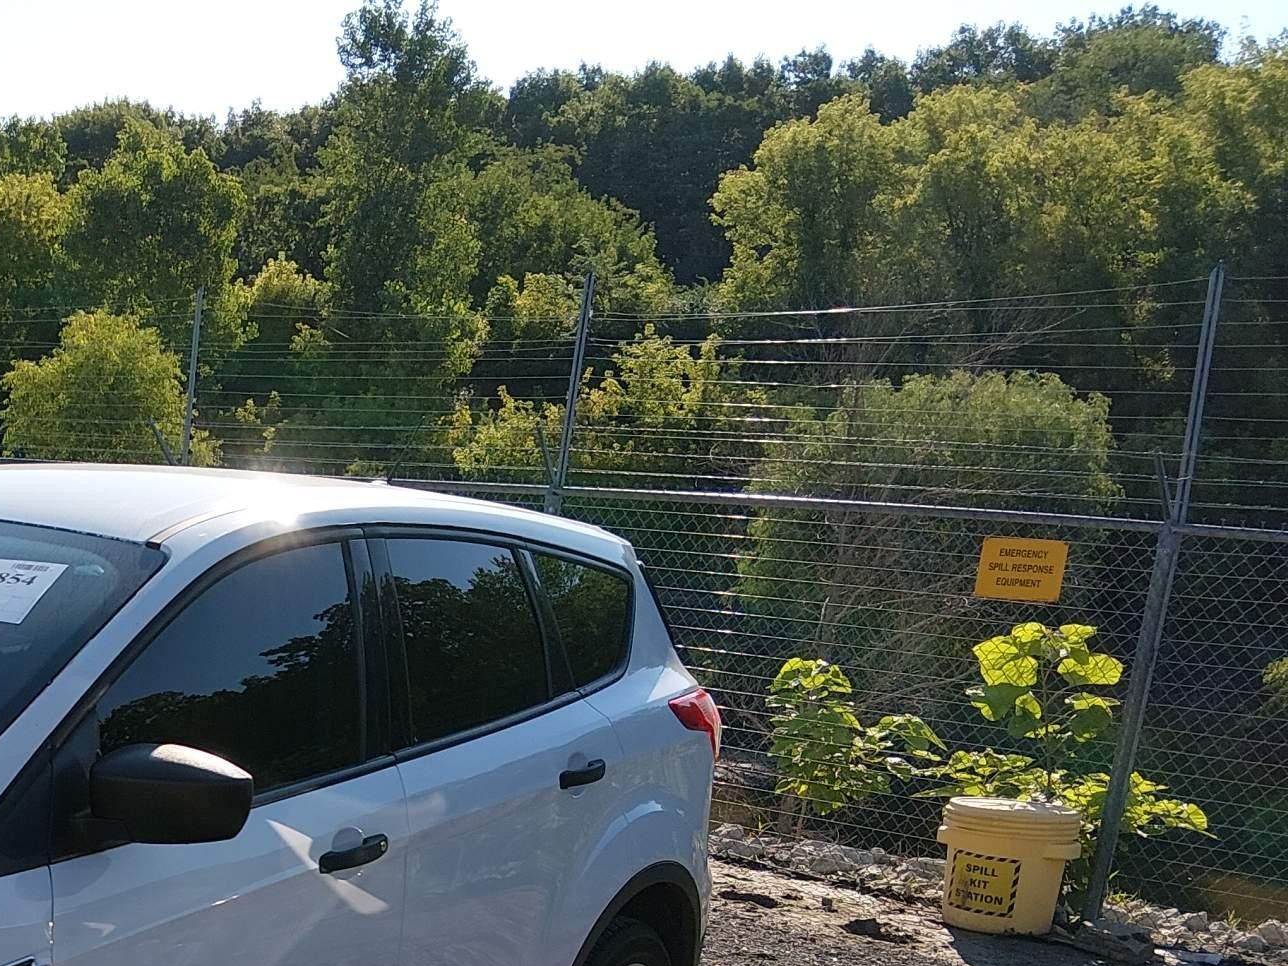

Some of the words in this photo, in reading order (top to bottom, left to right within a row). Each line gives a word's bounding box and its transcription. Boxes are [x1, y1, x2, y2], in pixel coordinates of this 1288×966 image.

[999, 548, 1049, 559] EMERGENCY
[988, 562, 1009, 572] SPILL
[1011, 563, 1054, 574] RESPONSE
[995, 577, 1041, 588] EQUIPMENT
[965, 863, 999, 878] SPILL
[969, 878, 990, 890] KIT
[955, 887, 1004, 905] STATION
